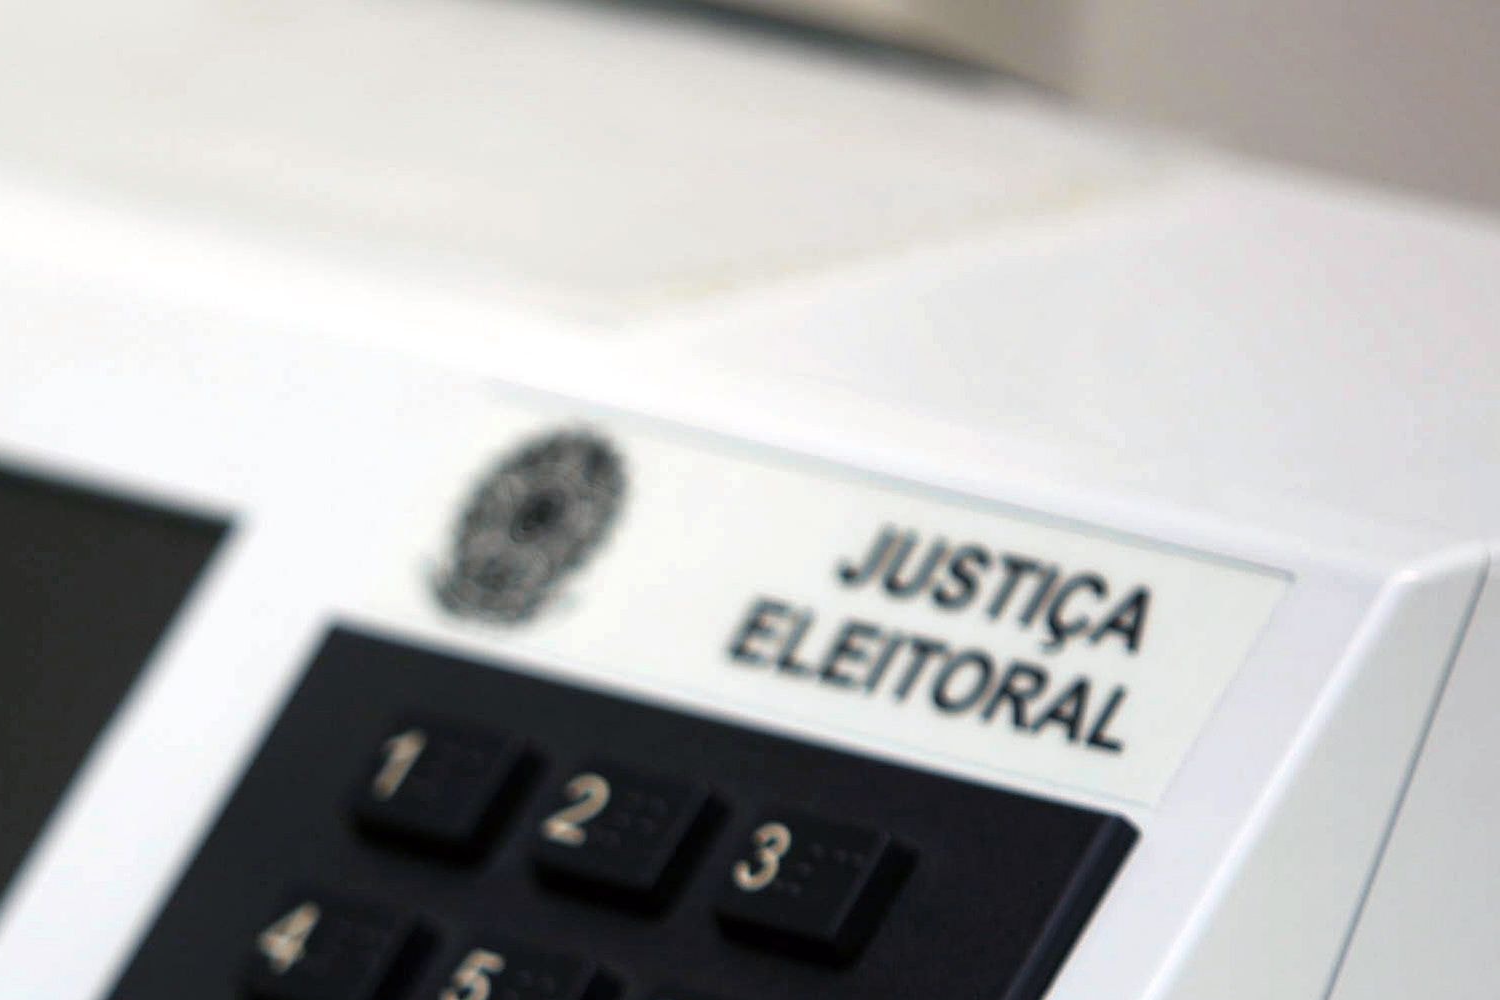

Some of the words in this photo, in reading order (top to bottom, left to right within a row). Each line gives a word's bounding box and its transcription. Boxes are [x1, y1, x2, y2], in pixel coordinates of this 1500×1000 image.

[835, 526, 1154, 657] JUSTIÇA
[724, 596, 1128, 757] ELEITORAL
[373, 729, 426, 798] 1
[543, 774, 611, 845] 2
[733, 822, 792, 891] 3
[258, 903, 320, 974] 4
